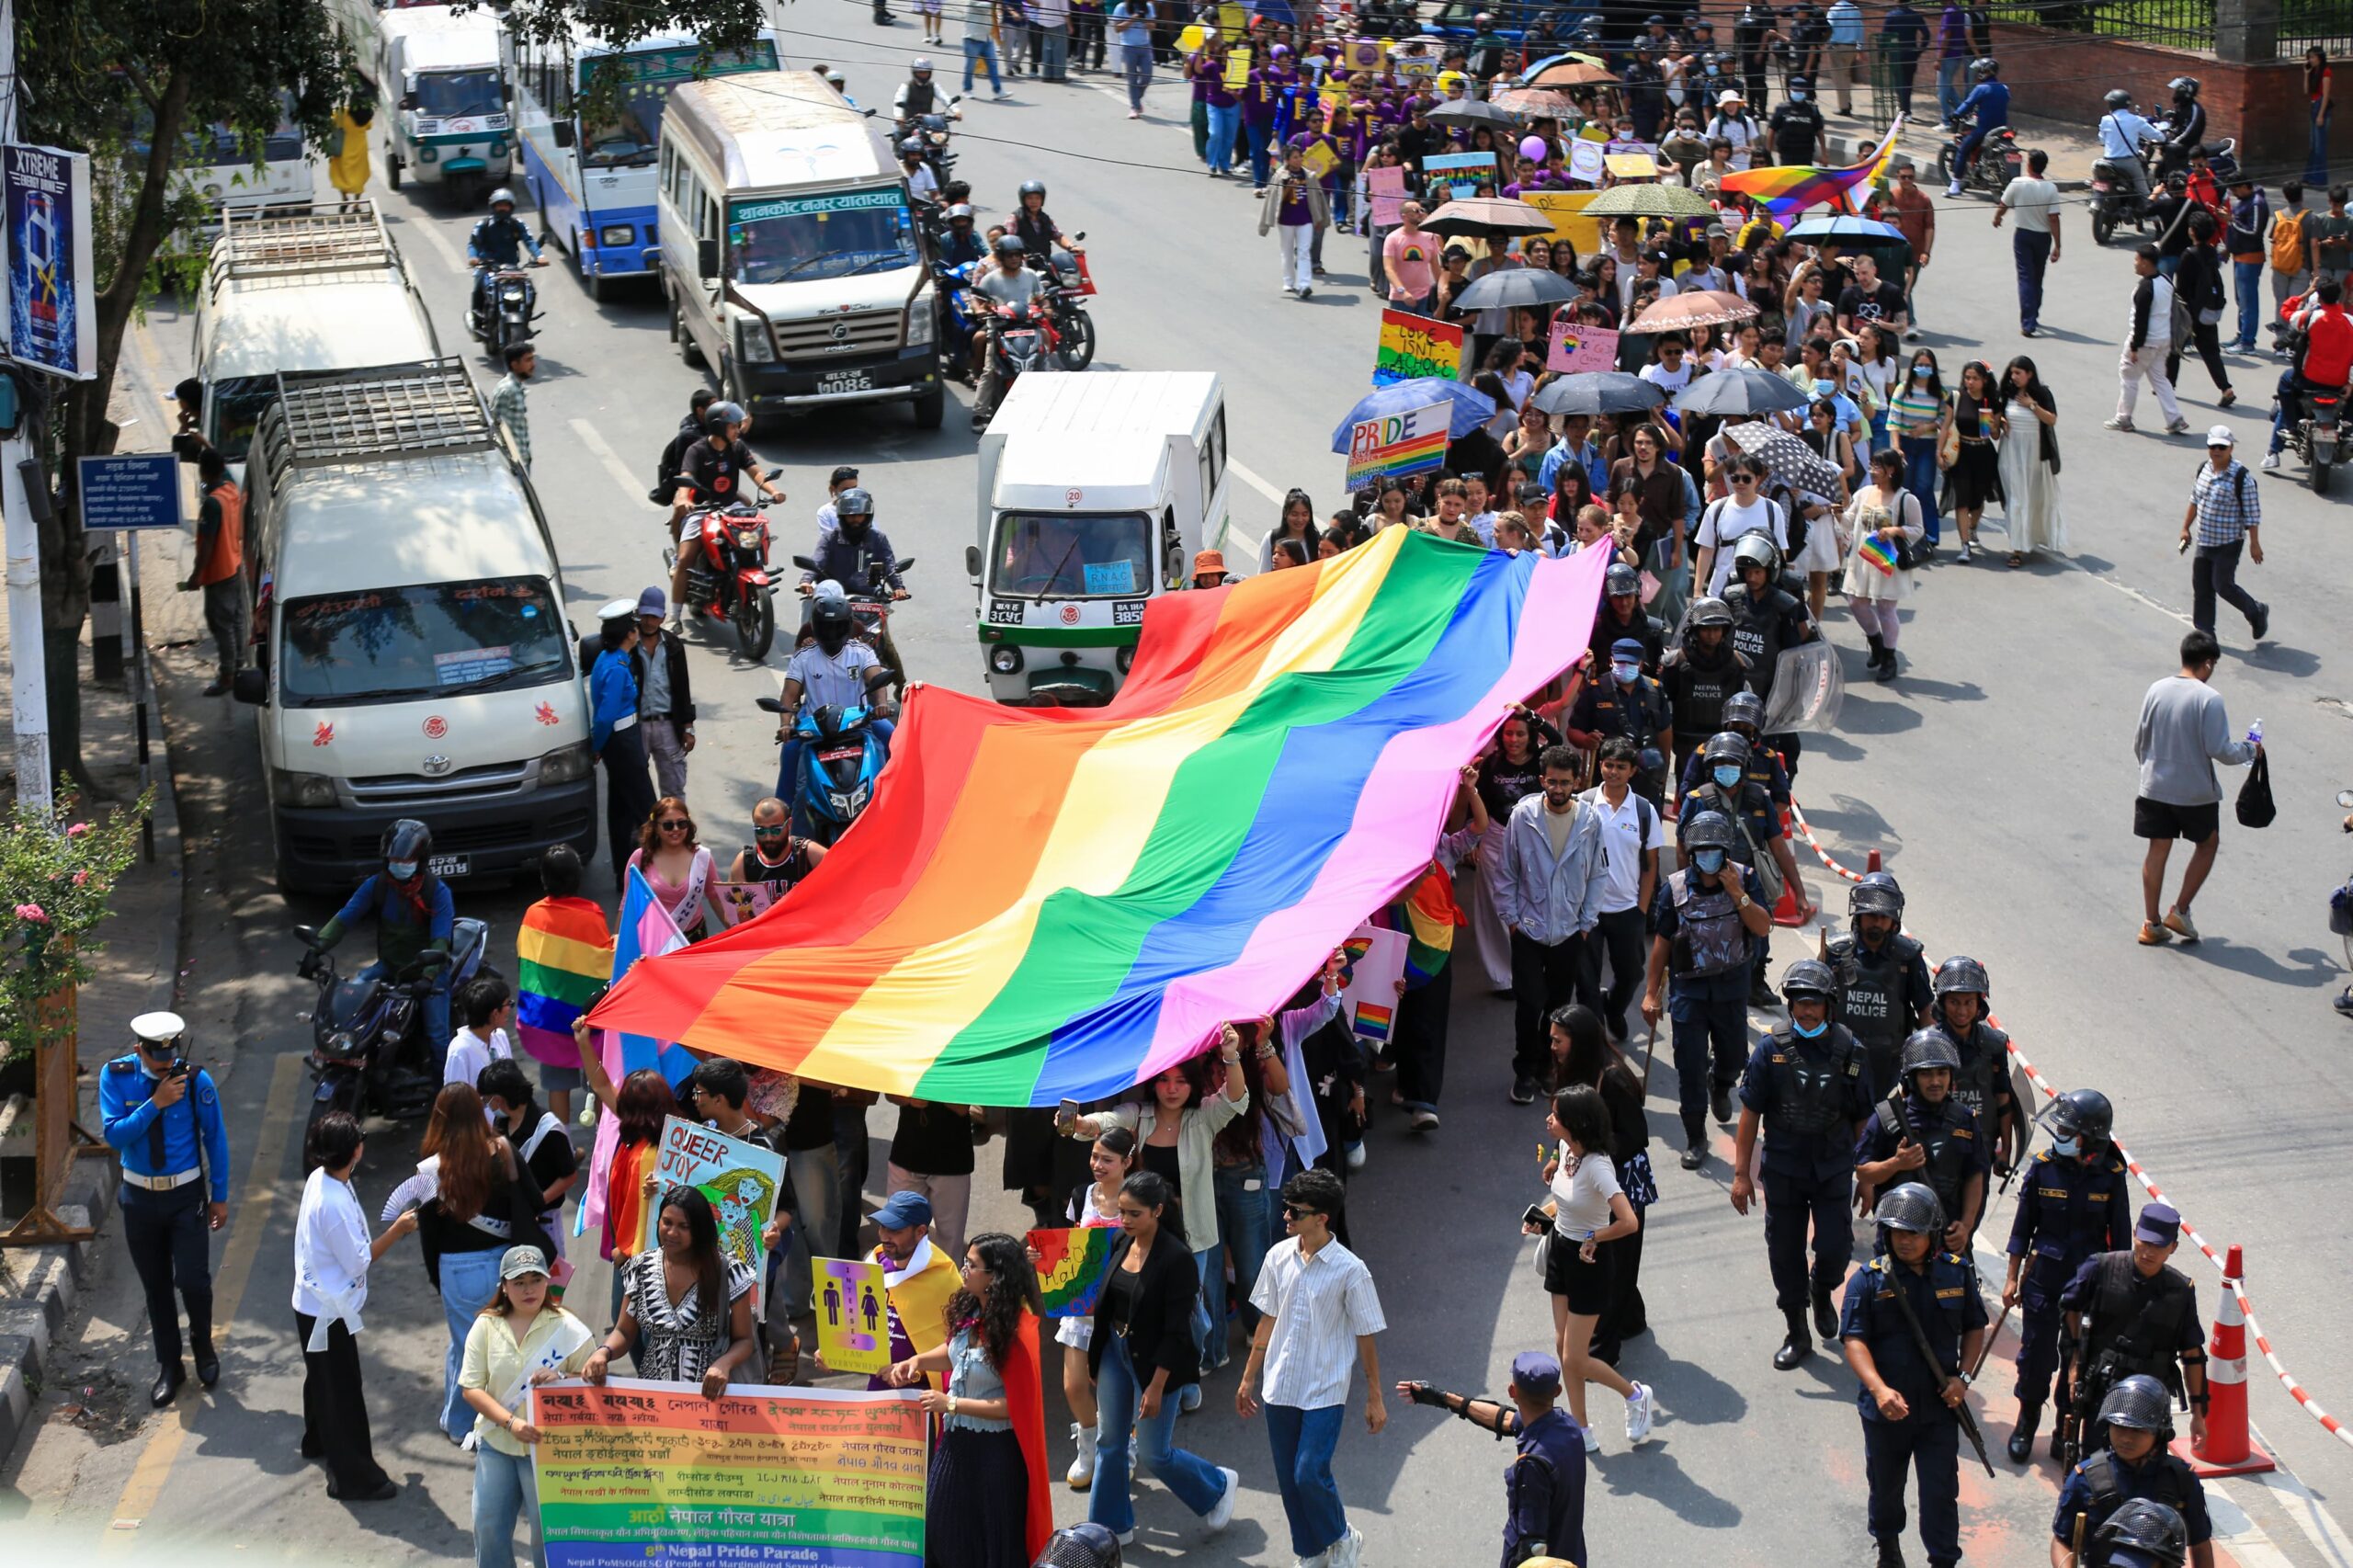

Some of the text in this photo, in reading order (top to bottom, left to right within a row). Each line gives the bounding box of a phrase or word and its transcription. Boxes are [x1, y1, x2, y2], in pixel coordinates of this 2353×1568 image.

[15, 148, 59, 181] XTREME
[19, 174, 40, 189] ENERGY
[738, 193, 902, 221] थानकोट नगर यातायात
[1399, 326, 1437, 345] LOVE
[1553, 323, 1584, 335] HOMO
[1352, 412, 1416, 454] PRIDE
[1068, 492, 1080, 501] 20
[1117, 602, 1128, 611] BA
[990, 610, 1022, 623] ३८५८
[1734, 630, 1765, 643] NEPAL
[1733, 641, 1764, 653] POLICE
[1847, 990, 1888, 1005] NEPAL
[1846, 1004, 1887, 1017] POLICE
[670, 1126, 729, 1168] QUEER
[662, 1149, 700, 1185] JOY
[846, 1267, 856, 1345] INTERSEX
[552, 1447, 582, 1460] नेपाल
[842, 1441, 870, 1452] नेपाल
[873, 1441, 896, 1455] गौरव
[898, 1447, 924, 1458] जात्रा
[833, 1475, 859, 1486] नेपाल
[561, 1487, 582, 1497] नेपाल
[819, 1491, 844, 1503] नेपाल
[669, 1505, 714, 1525] नेपाल
[717, 1506, 756, 1527] गौरव
[759, 1513, 796, 1528] यात्रा
[645, 1544, 819, 1561] 8th Nepal Pride Parade
[567, 1558, 595, 1568] Nepal
